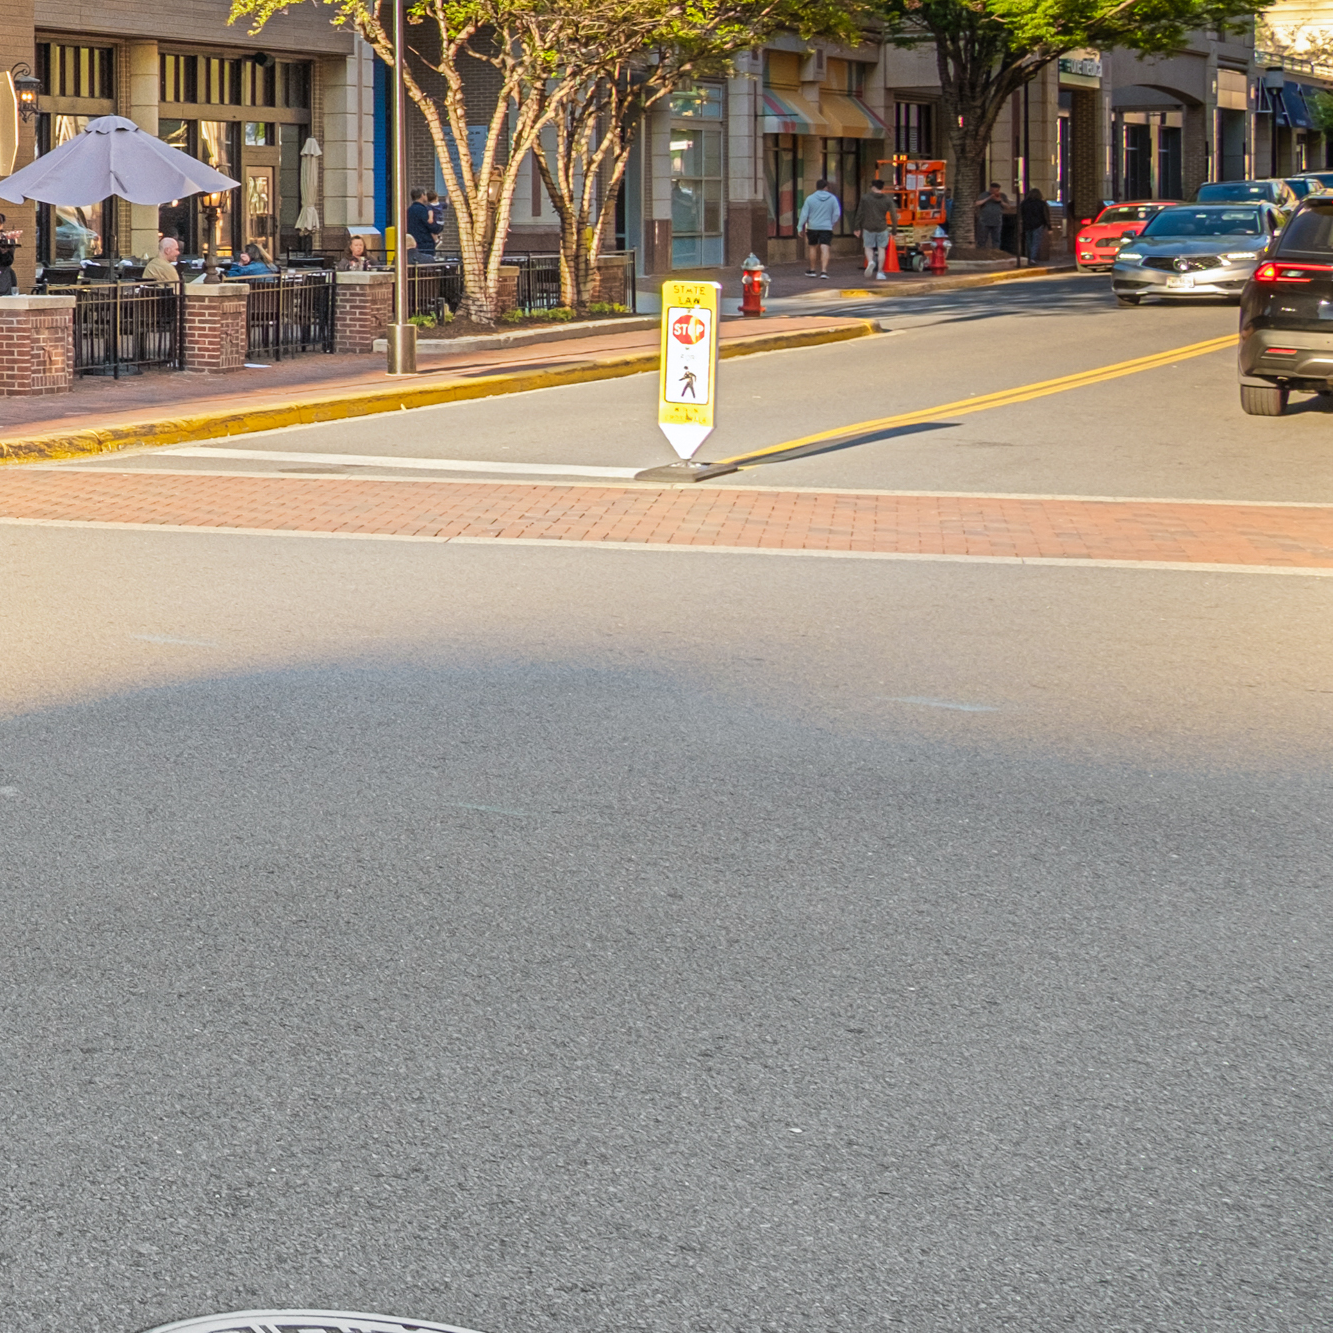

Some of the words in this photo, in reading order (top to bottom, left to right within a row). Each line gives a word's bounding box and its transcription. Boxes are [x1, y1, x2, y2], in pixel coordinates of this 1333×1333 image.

[673, 284, 706, 296] STATE
[678, 296, 701, 305] LAW
[673, 323, 704, 336] STOP
